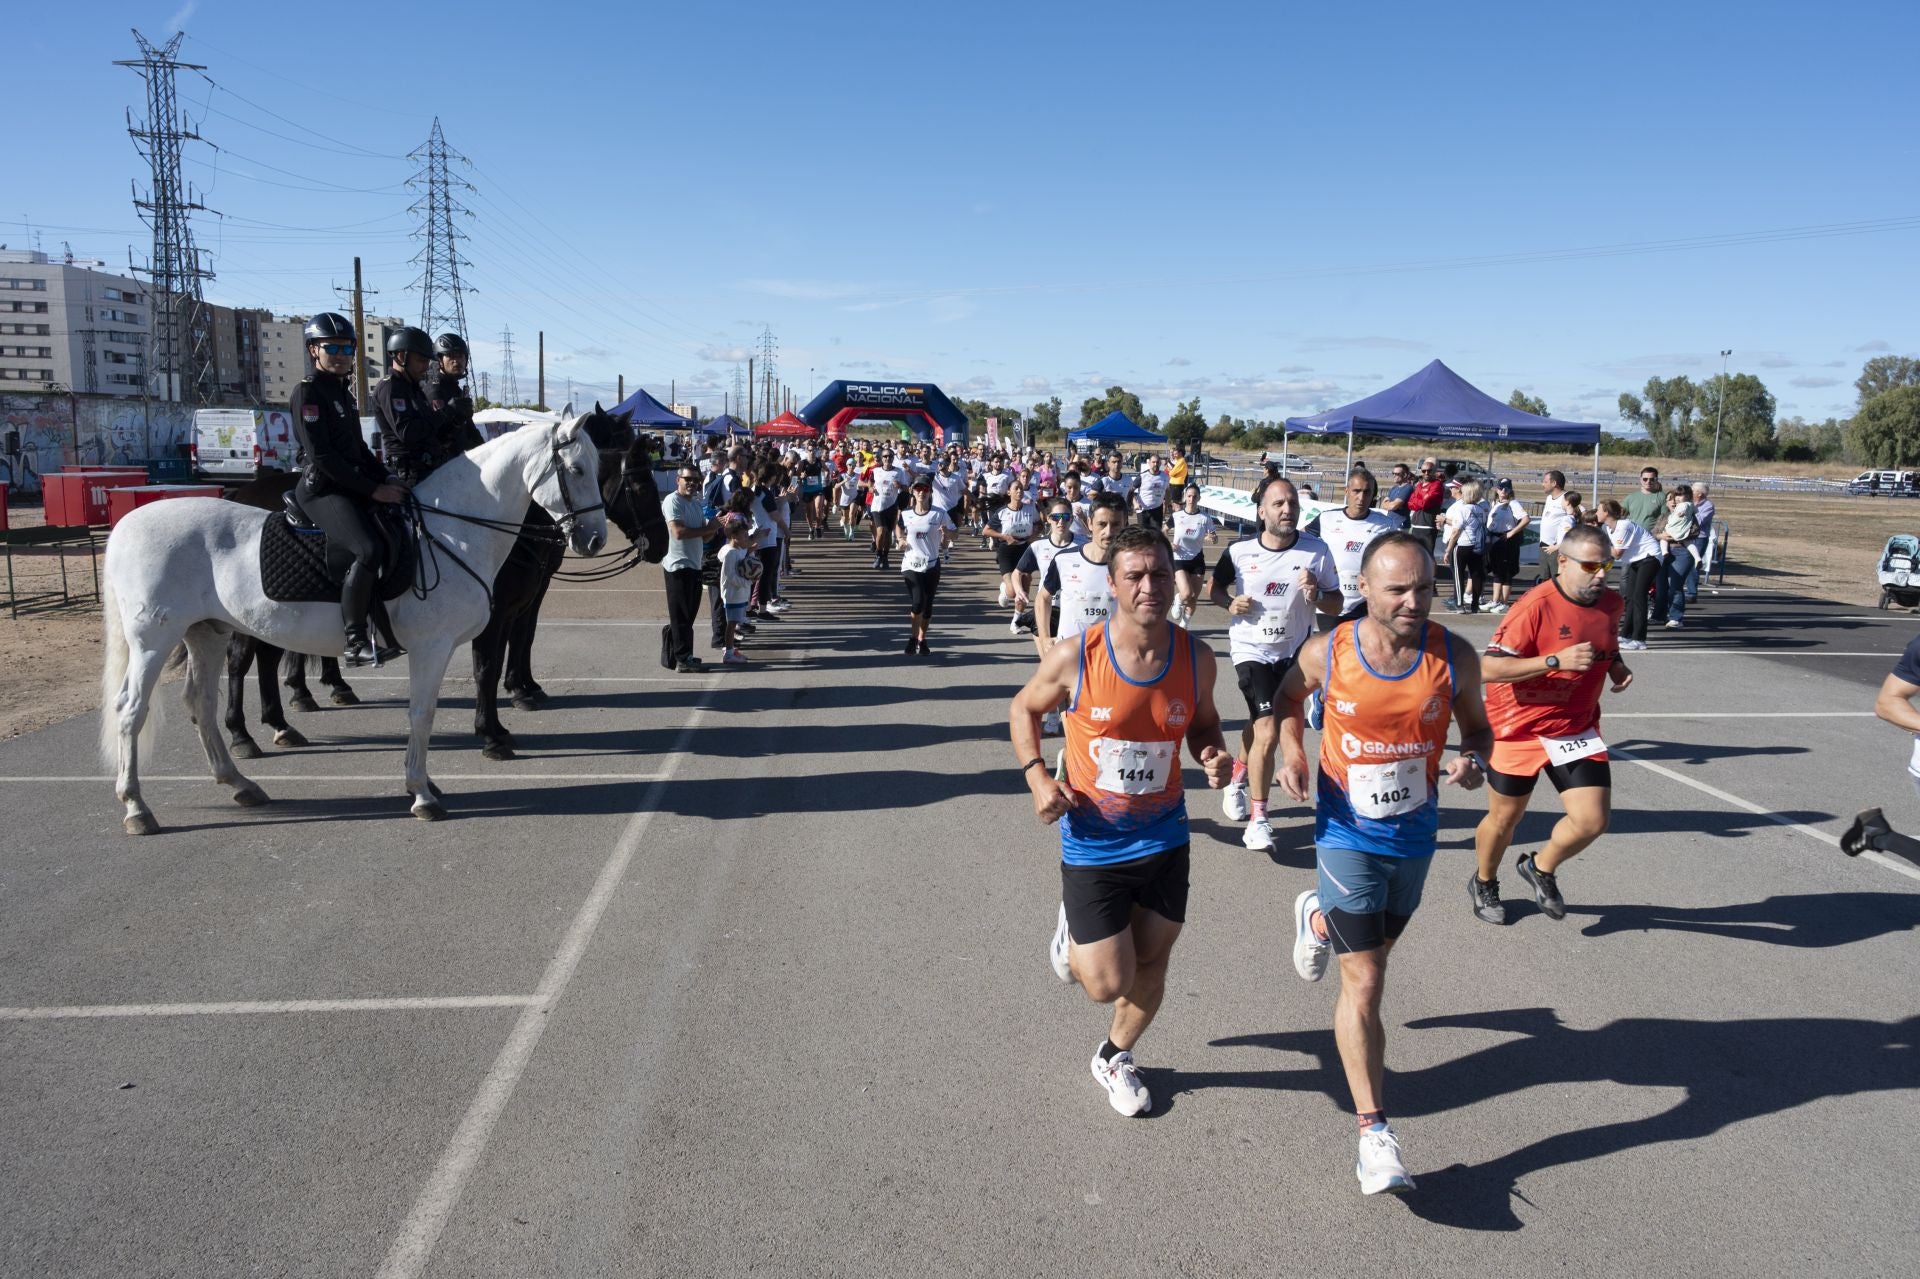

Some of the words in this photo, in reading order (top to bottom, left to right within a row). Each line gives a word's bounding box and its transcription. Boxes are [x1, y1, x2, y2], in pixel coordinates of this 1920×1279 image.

[847, 385, 907, 395] POLICIA
[846, 394, 923, 404] NACIONAL
[1084, 608, 1107, 616] 1390
[1263, 627, 1286, 636] 1342
[1090, 707, 1113, 720] DK
[1337, 700, 1358, 716] DK
[1364, 740, 1436, 754] GRANISUL
[1560, 739, 1588, 754] 1215
[1117, 768, 1155, 781] 1414
[1371, 787, 1411, 805] 1402
